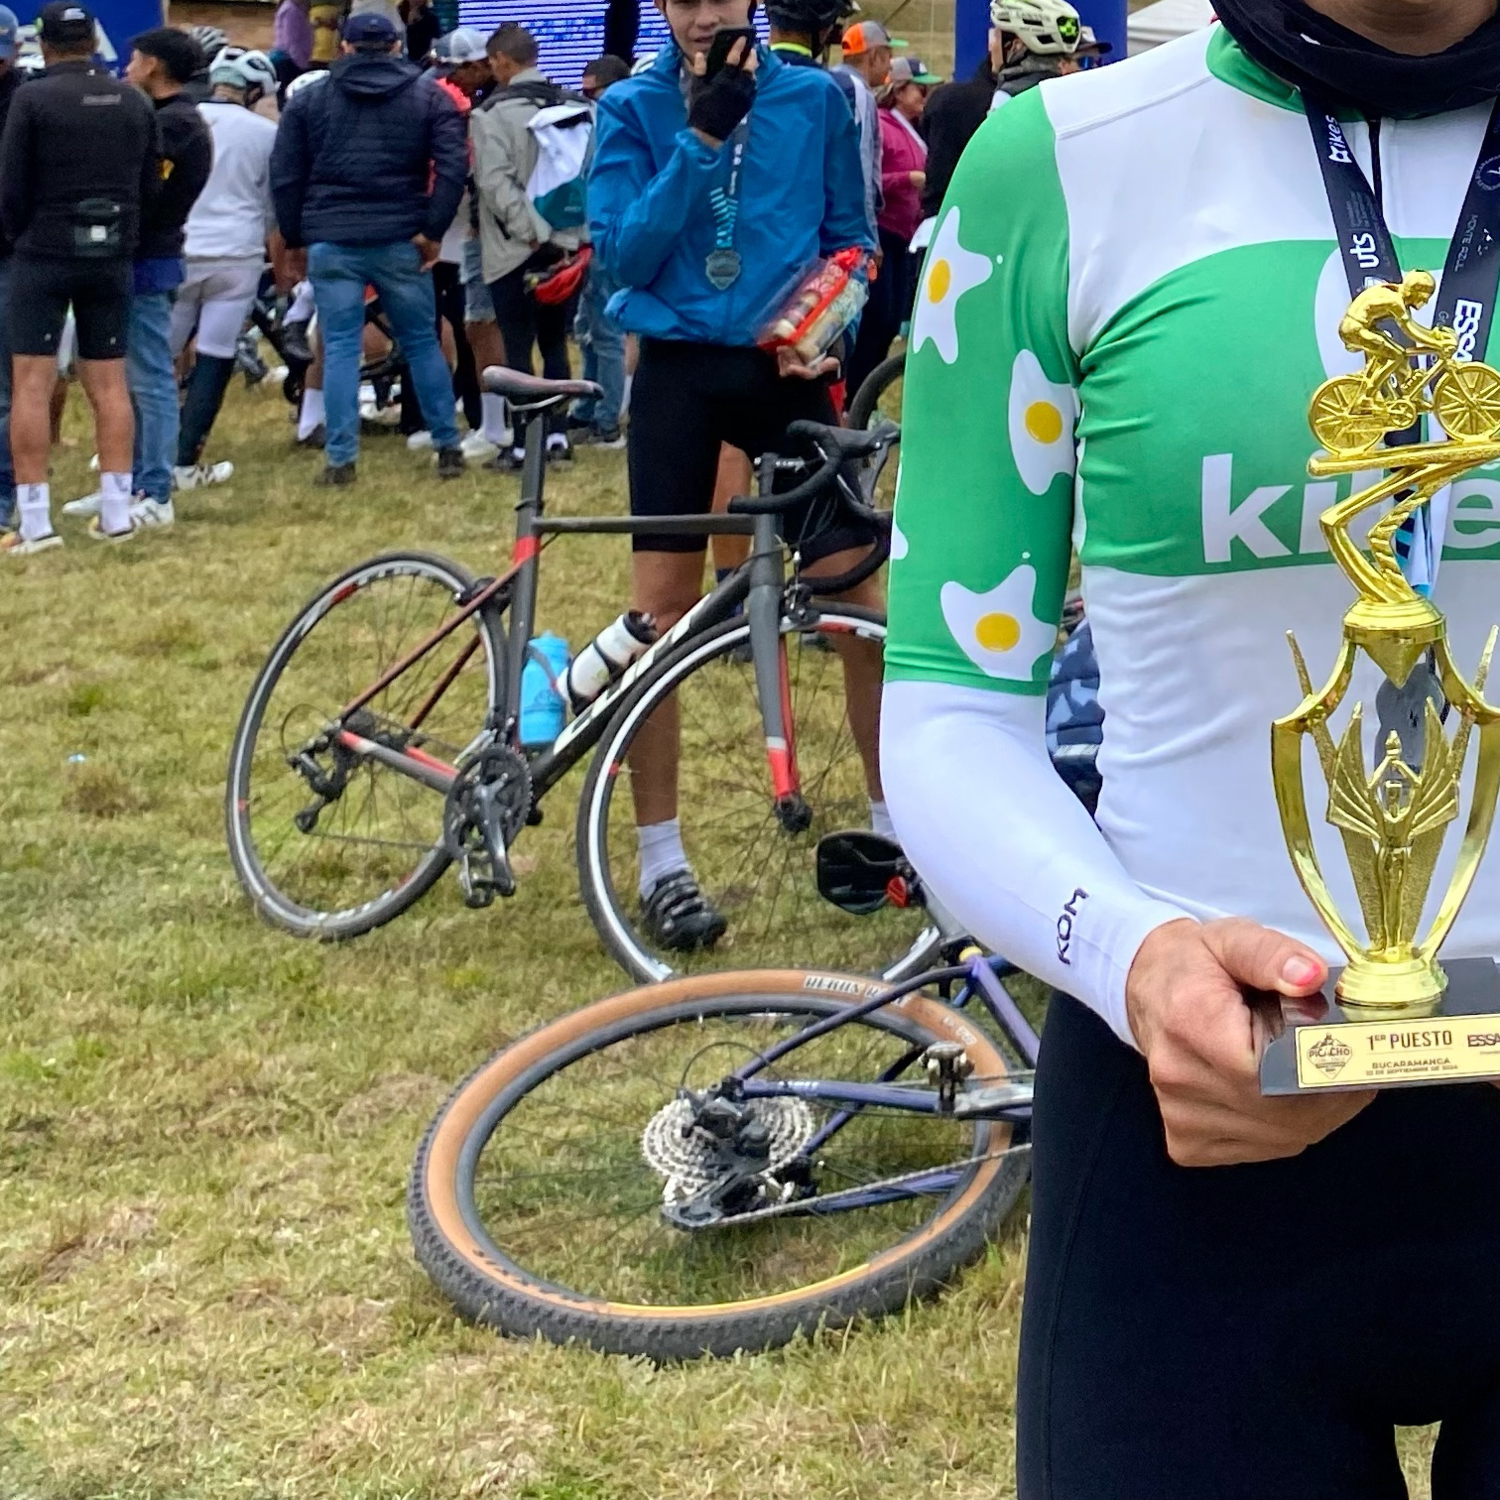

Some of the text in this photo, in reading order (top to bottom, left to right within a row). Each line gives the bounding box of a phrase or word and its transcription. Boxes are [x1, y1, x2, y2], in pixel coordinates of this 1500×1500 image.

[1451, 299, 1483, 362] ESSA
[1057, 888, 1089, 966] KOM
[1390, 1030, 1452, 1049] PUESTO
